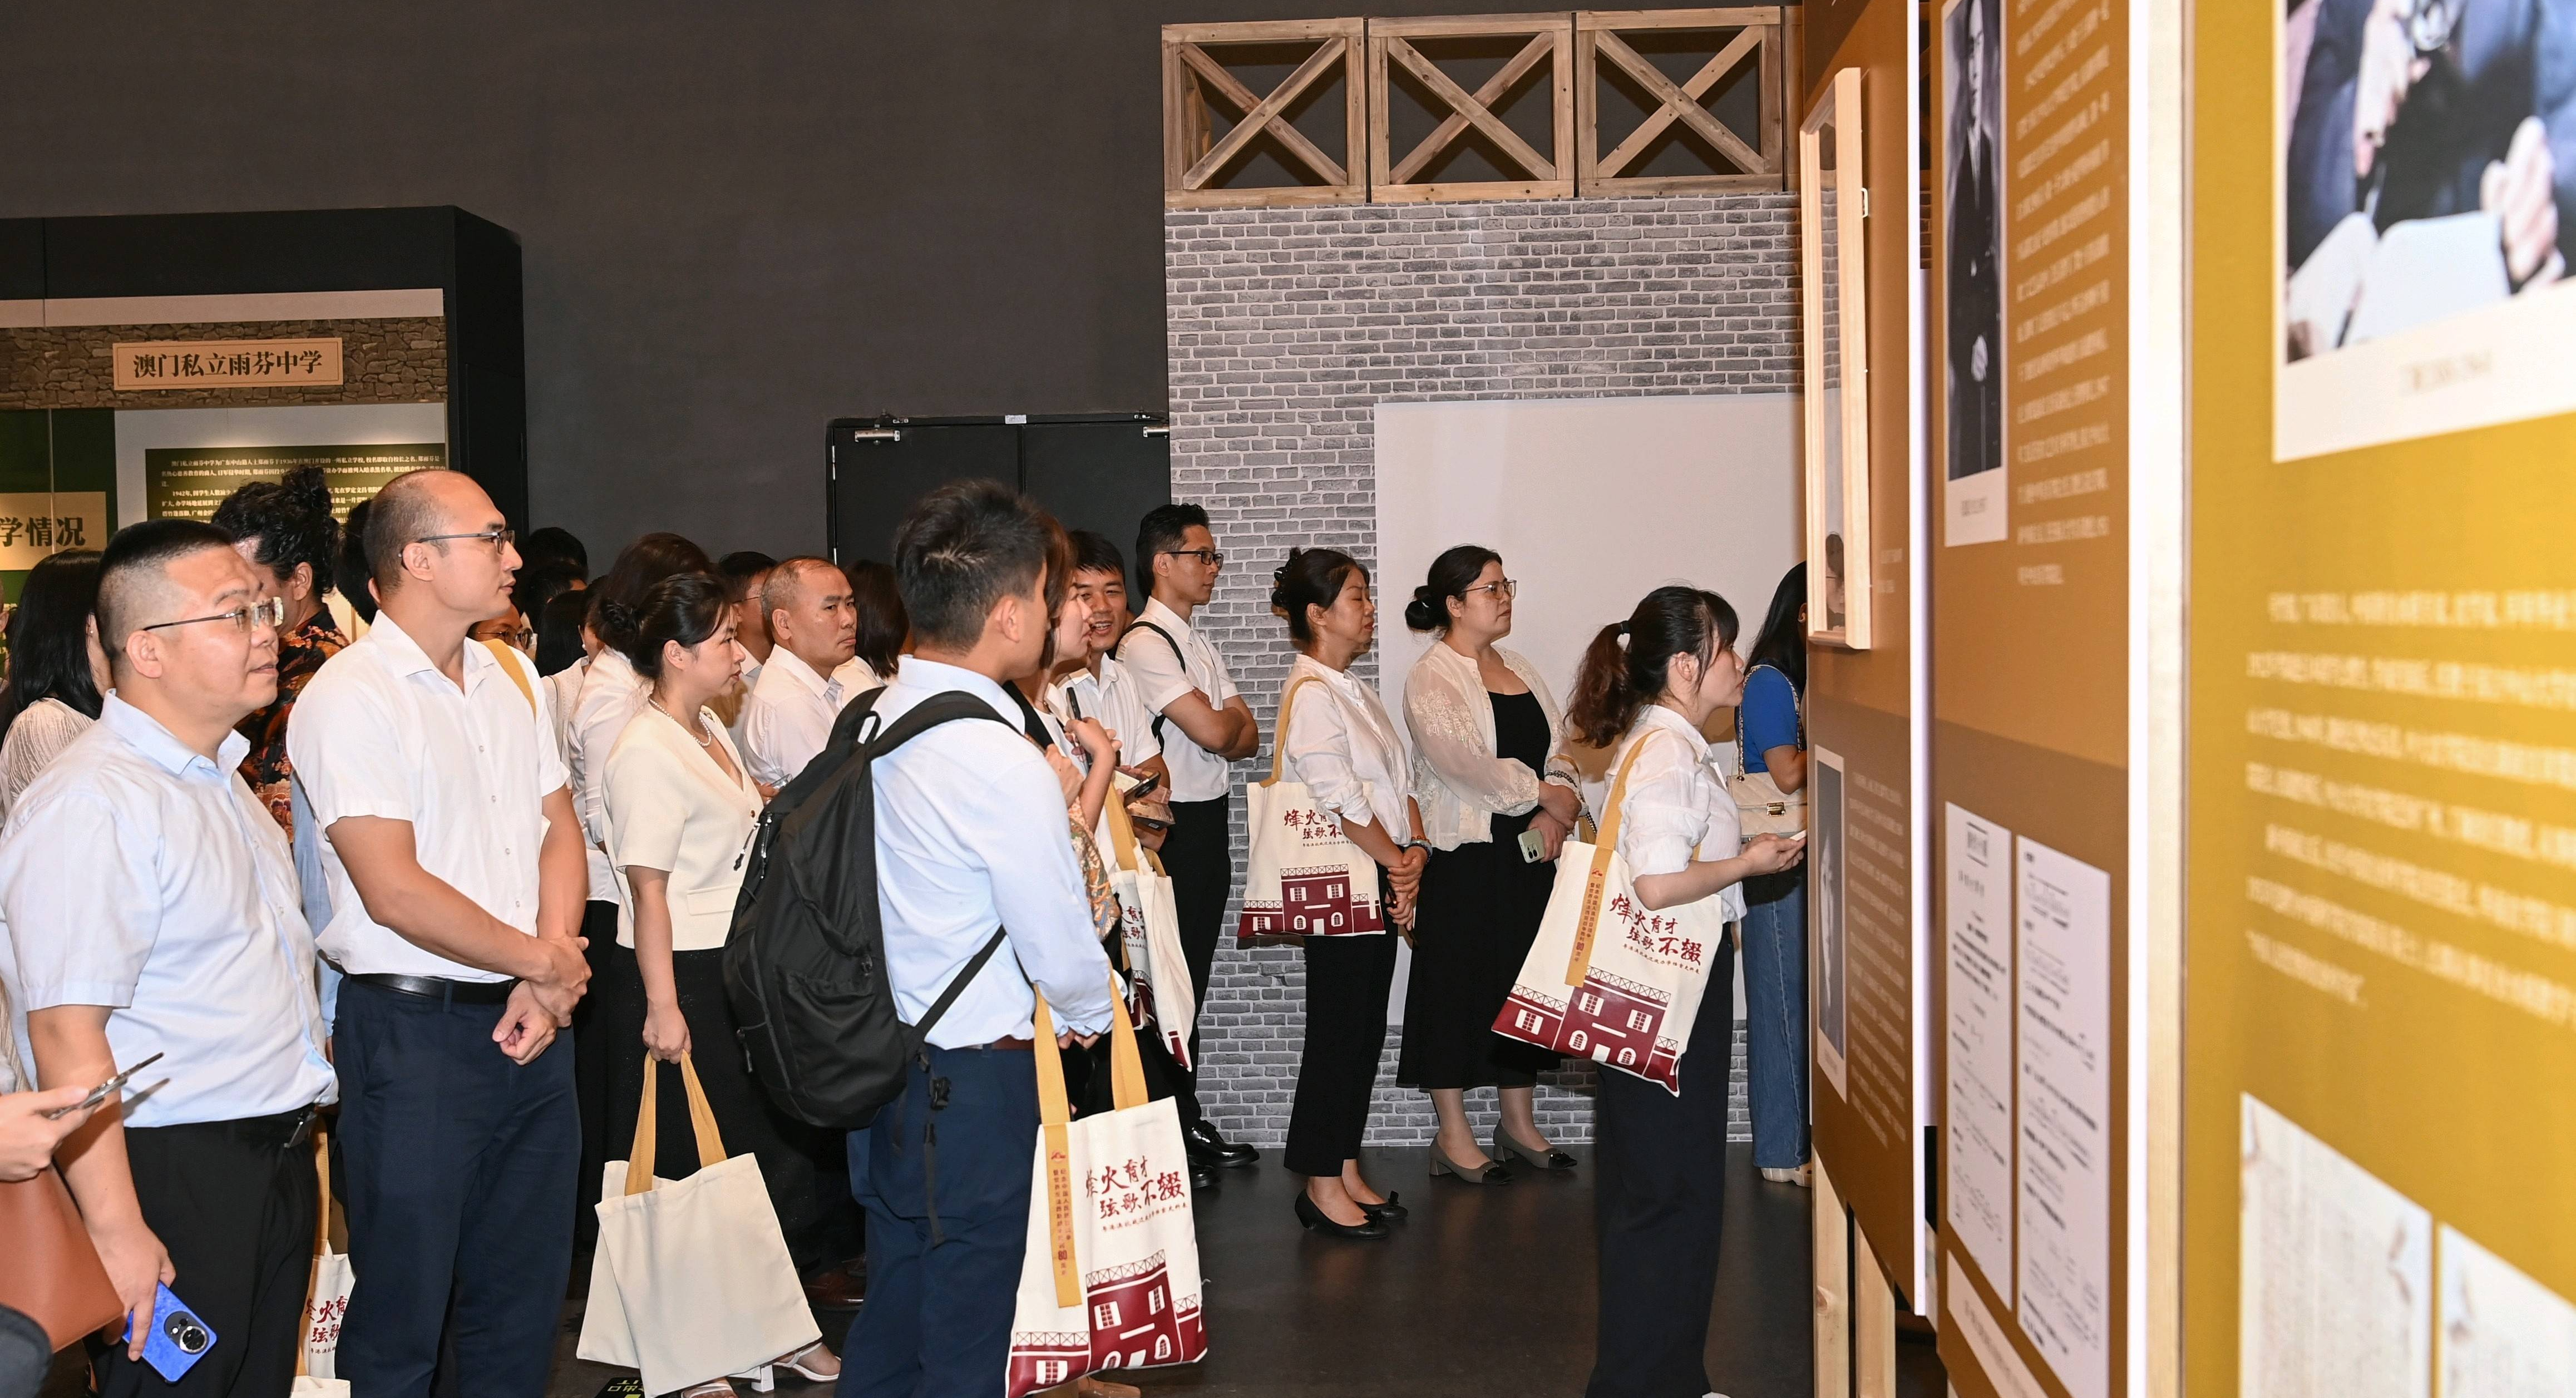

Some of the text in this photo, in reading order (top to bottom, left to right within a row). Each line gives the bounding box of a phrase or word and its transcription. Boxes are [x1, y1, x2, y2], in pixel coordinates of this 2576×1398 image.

[134, 349, 323, 378] 澳门私立雨芬中学
[0, 517, 86, 547] 学情况
[1609, 893, 1679, 935] 烽火育才
[1626, 926, 1702, 966] 弦歌不辍
[1099, 1171, 1185, 1219] 弦歌不辍
